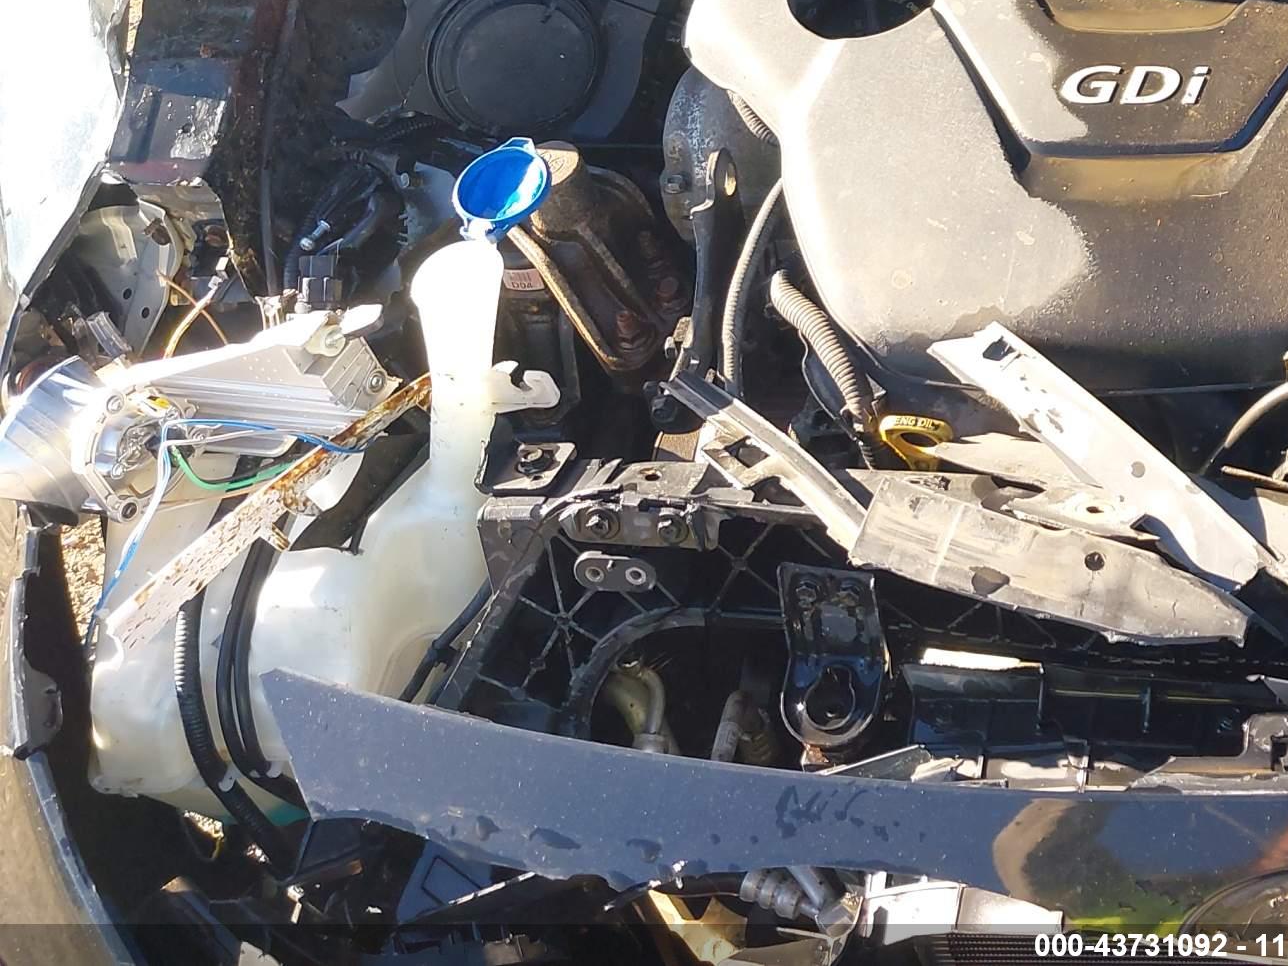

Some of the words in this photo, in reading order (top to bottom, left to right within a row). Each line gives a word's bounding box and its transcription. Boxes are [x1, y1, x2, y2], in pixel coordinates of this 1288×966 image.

[1060, 65, 1212, 105] GDi
[895, 416, 916, 427] ENG
[916, 418, 935, 429] OIL
